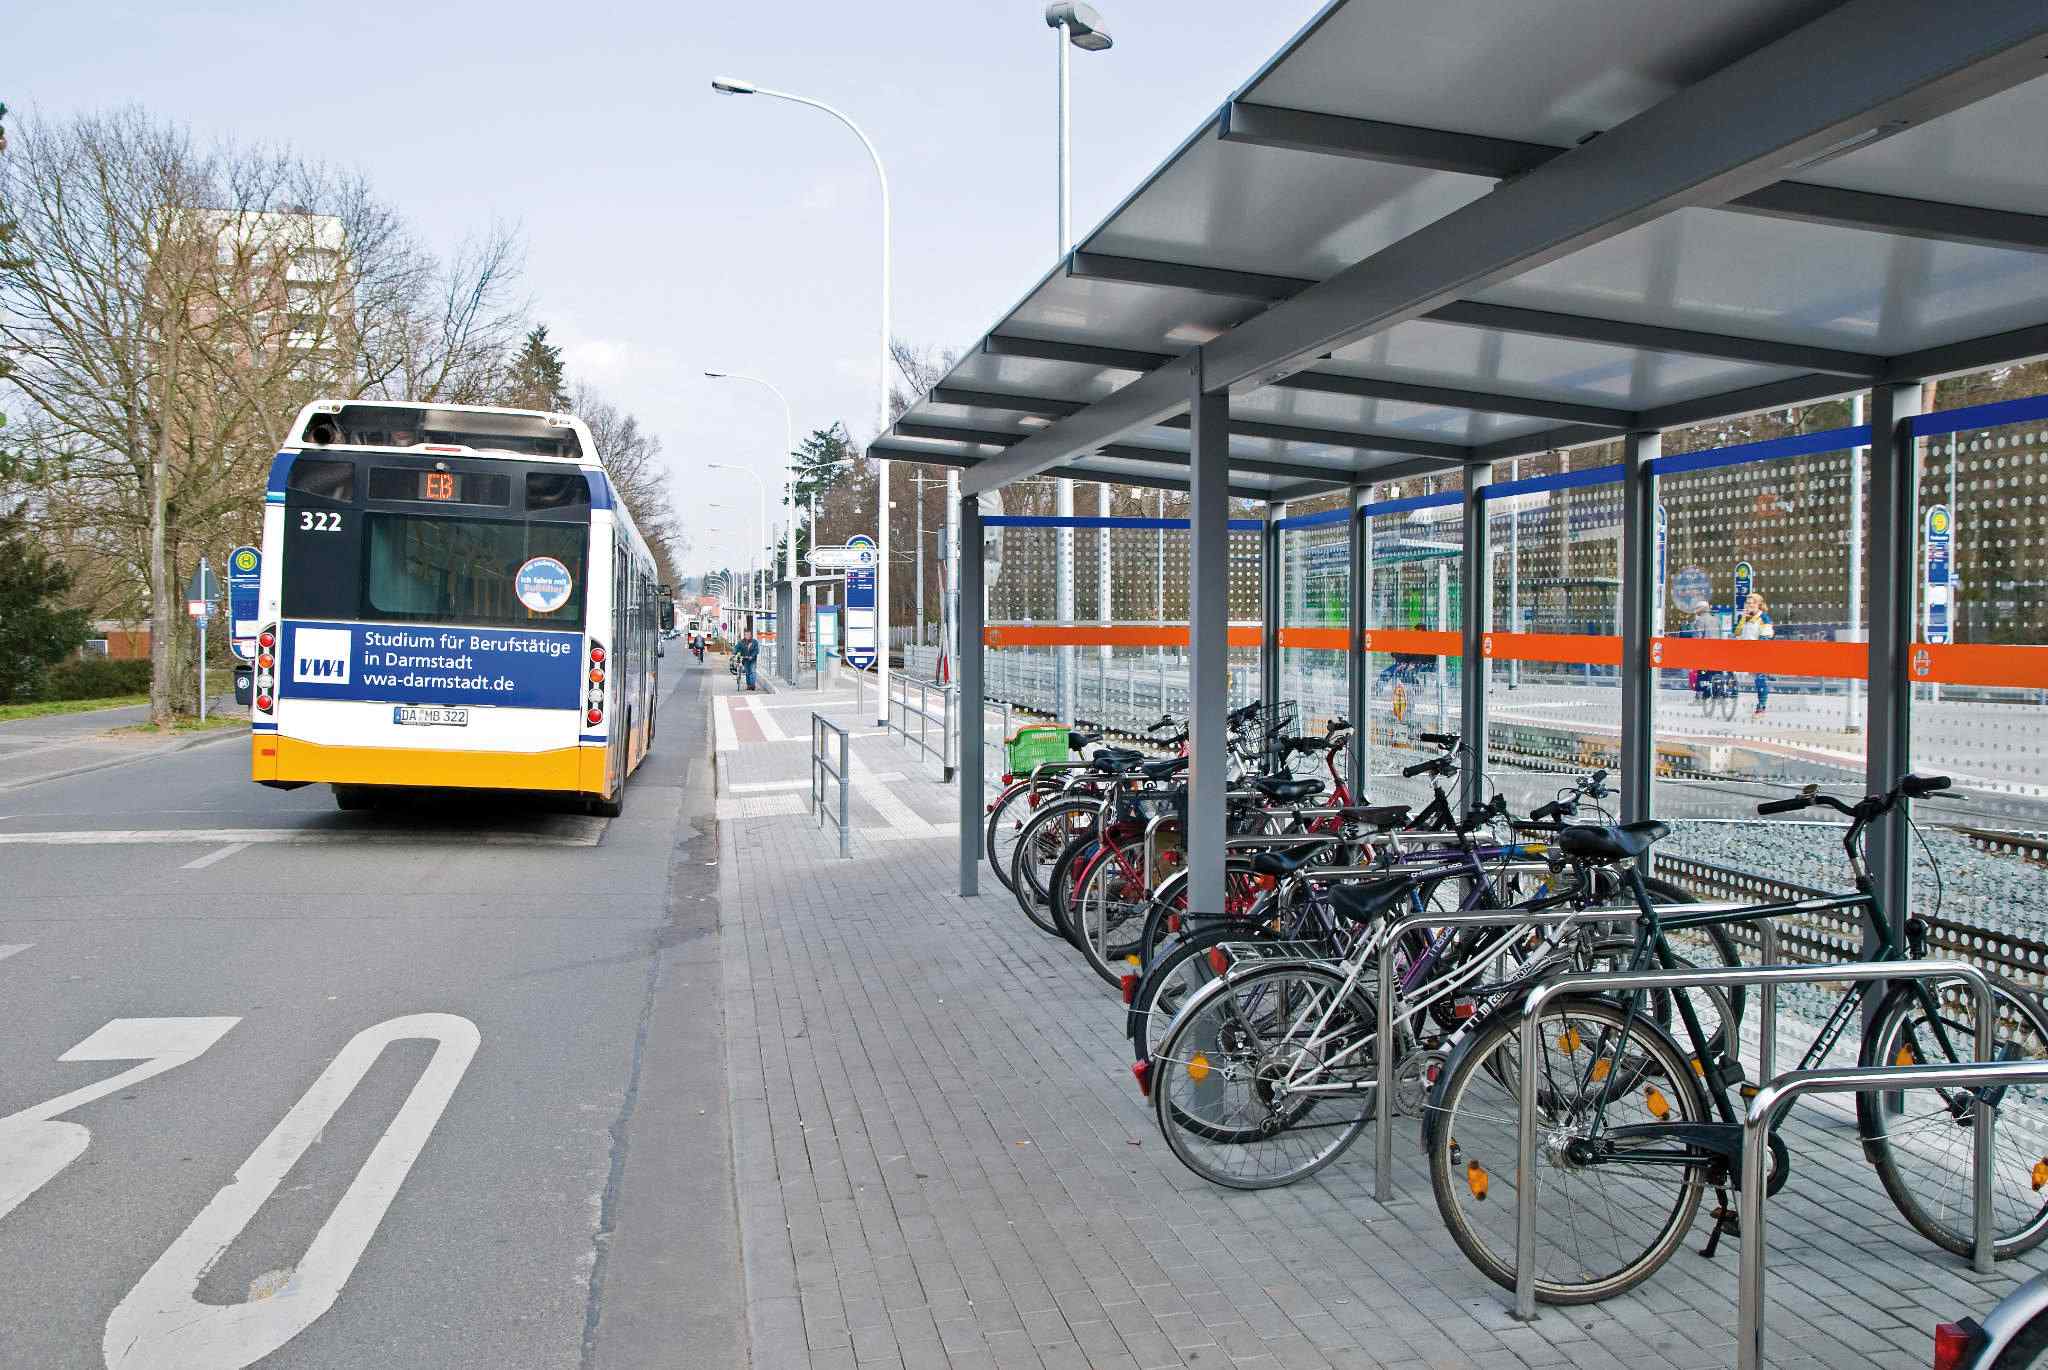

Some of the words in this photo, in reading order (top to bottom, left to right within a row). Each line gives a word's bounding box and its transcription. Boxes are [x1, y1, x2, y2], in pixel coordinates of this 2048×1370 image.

[300, 511, 342, 532] 322
[365, 631, 434, 648] Studium
[440, 633, 464, 649] für
[470, 635, 571, 657] Berufstätige
[364, 650, 380, 666] in
[385, 652, 472, 670] Darmstadt
[363, 672, 514, 691] vwa-darmstadt.de
[443, 710, 466, 723] 322
[1802, 991, 1861, 1072] EUGEOT
